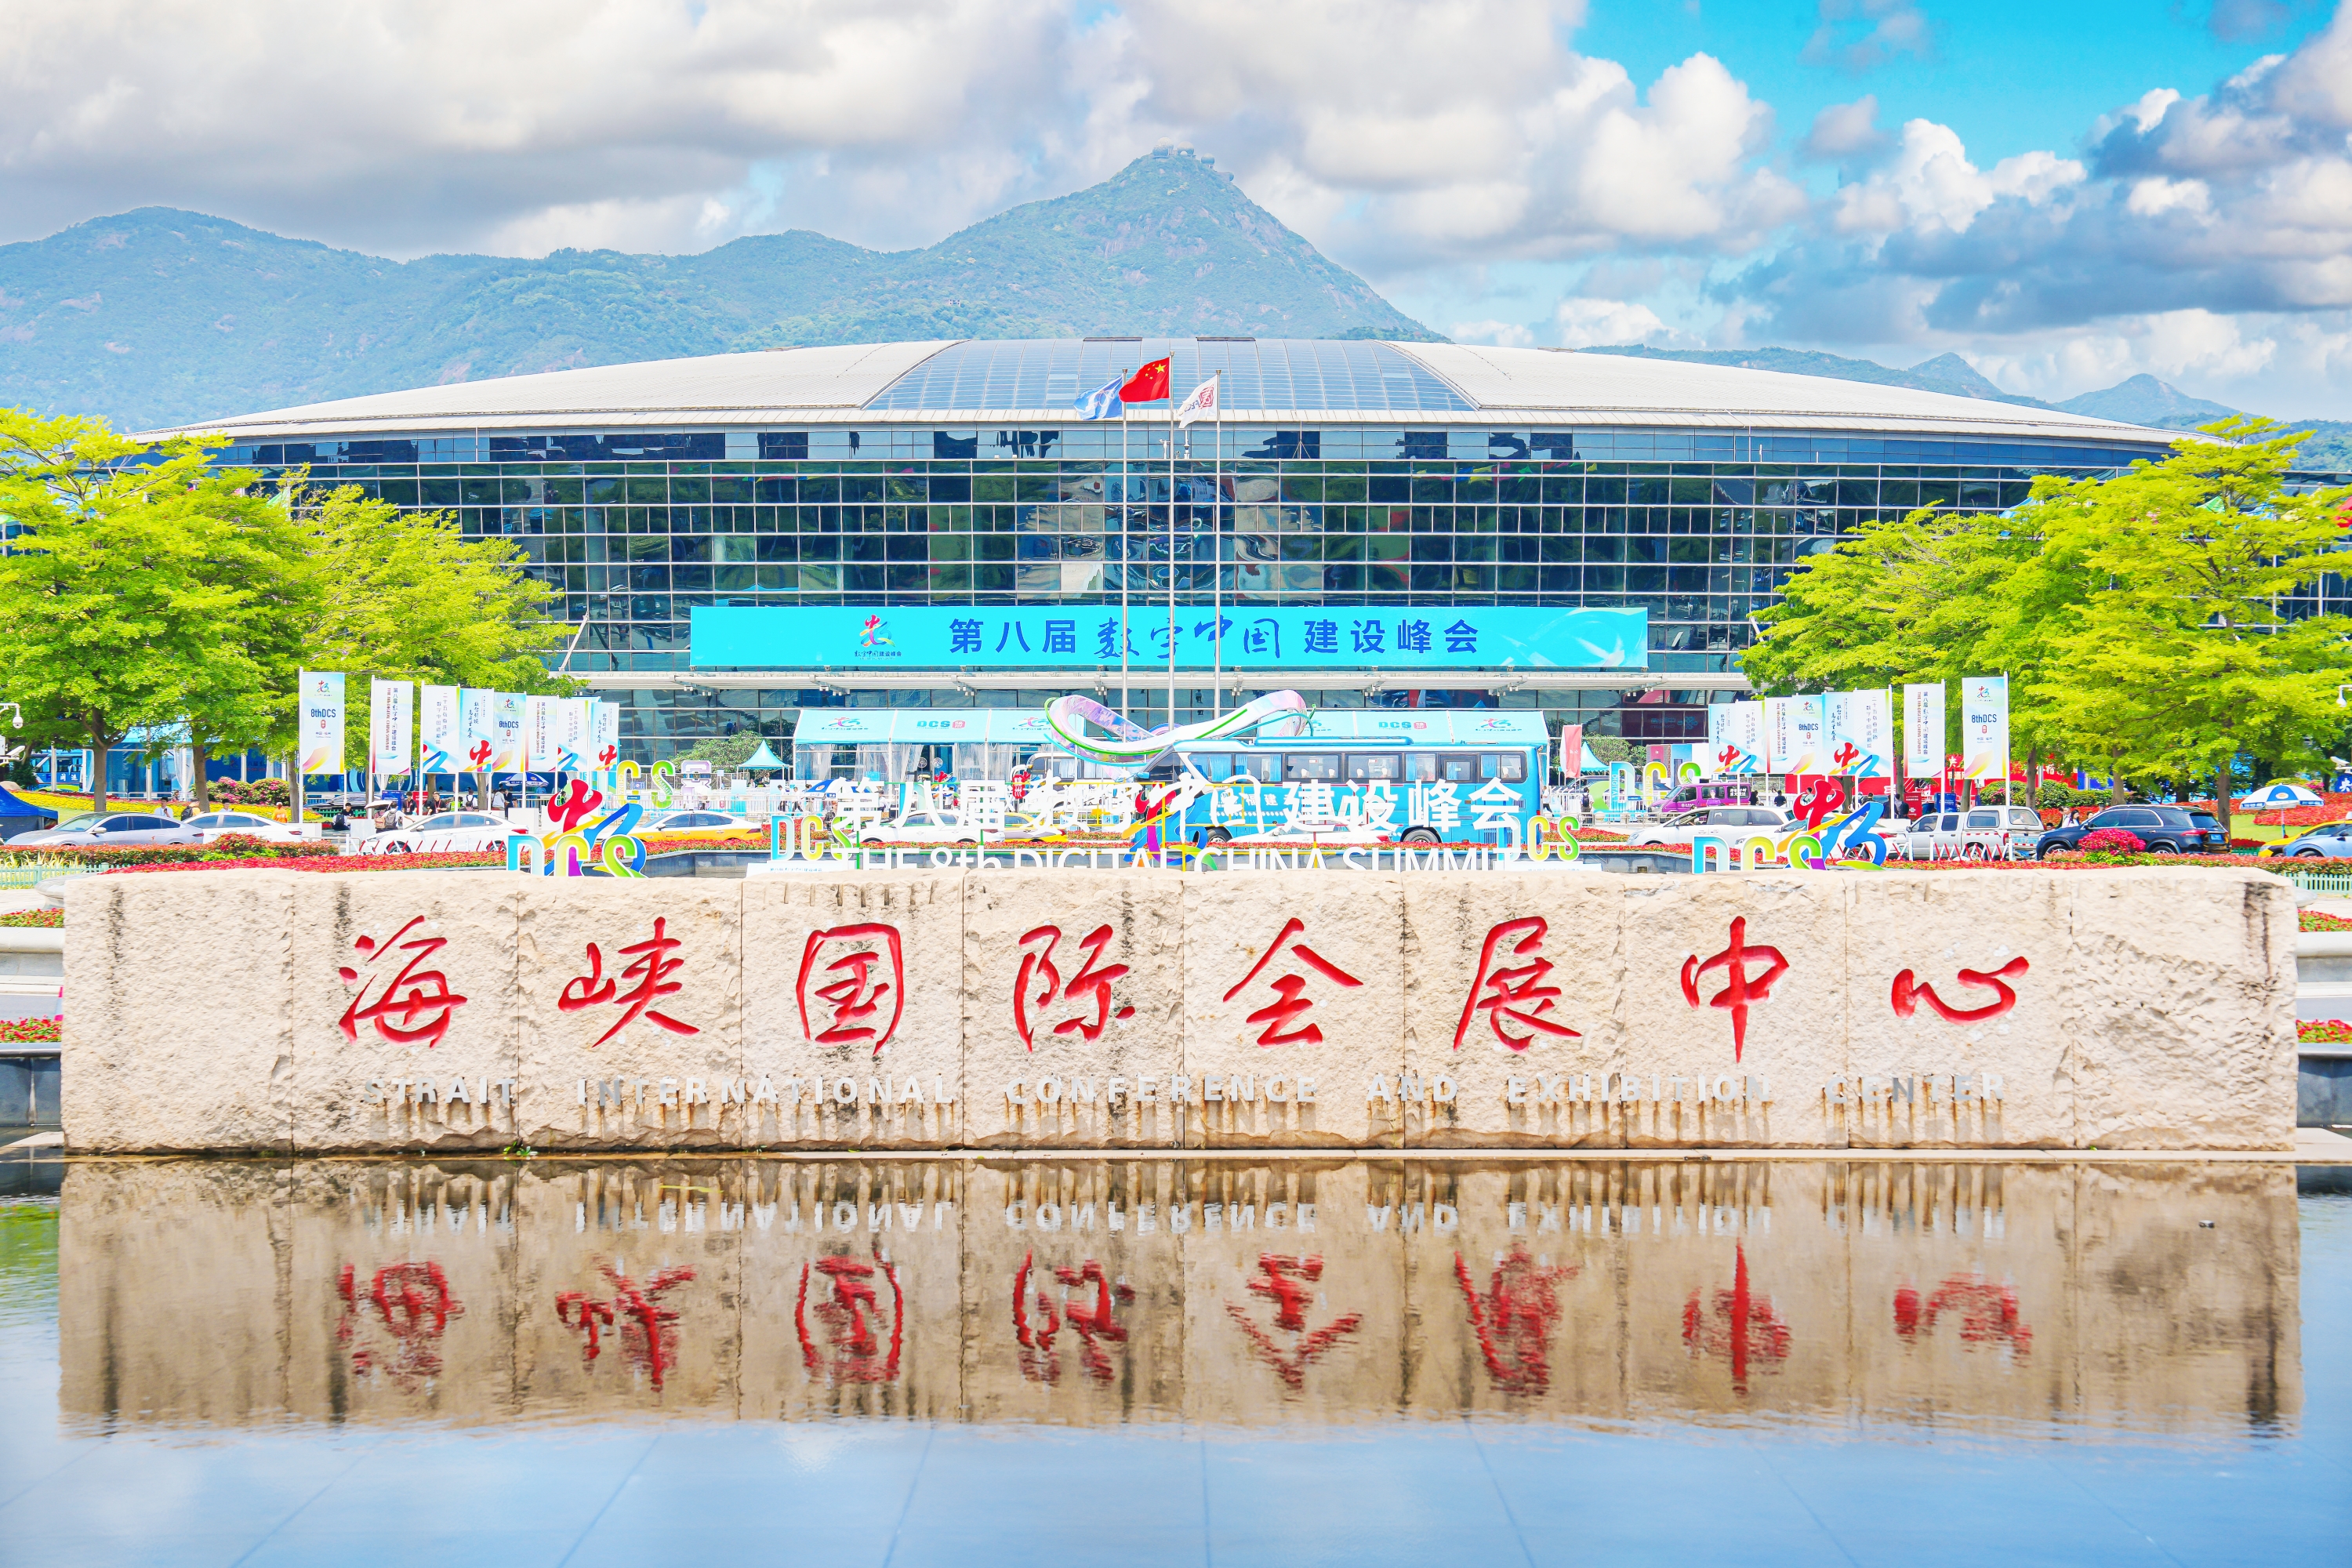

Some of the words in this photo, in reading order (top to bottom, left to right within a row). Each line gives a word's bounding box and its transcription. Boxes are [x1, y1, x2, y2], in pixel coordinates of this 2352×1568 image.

[949, 615, 1479, 660] 第八届数字中国建设峰会
[310, 709, 336, 718] 8thDCS
[1971, 713, 1997, 723] 8thDCS
[338, 915, 2029, 1063] 海峡国际会展中心
[364, 1076, 516, 1105] STRAIT
[577, 1076, 953, 1105] INTERNATIONAL
[1005, 1075, 1317, 1105] CONFERENCE
[1366, 1074, 1458, 1102] AND
[1507, 1074, 1772, 1104] EXHIBITION
[1824, 1075, 2005, 1105] CENTER
